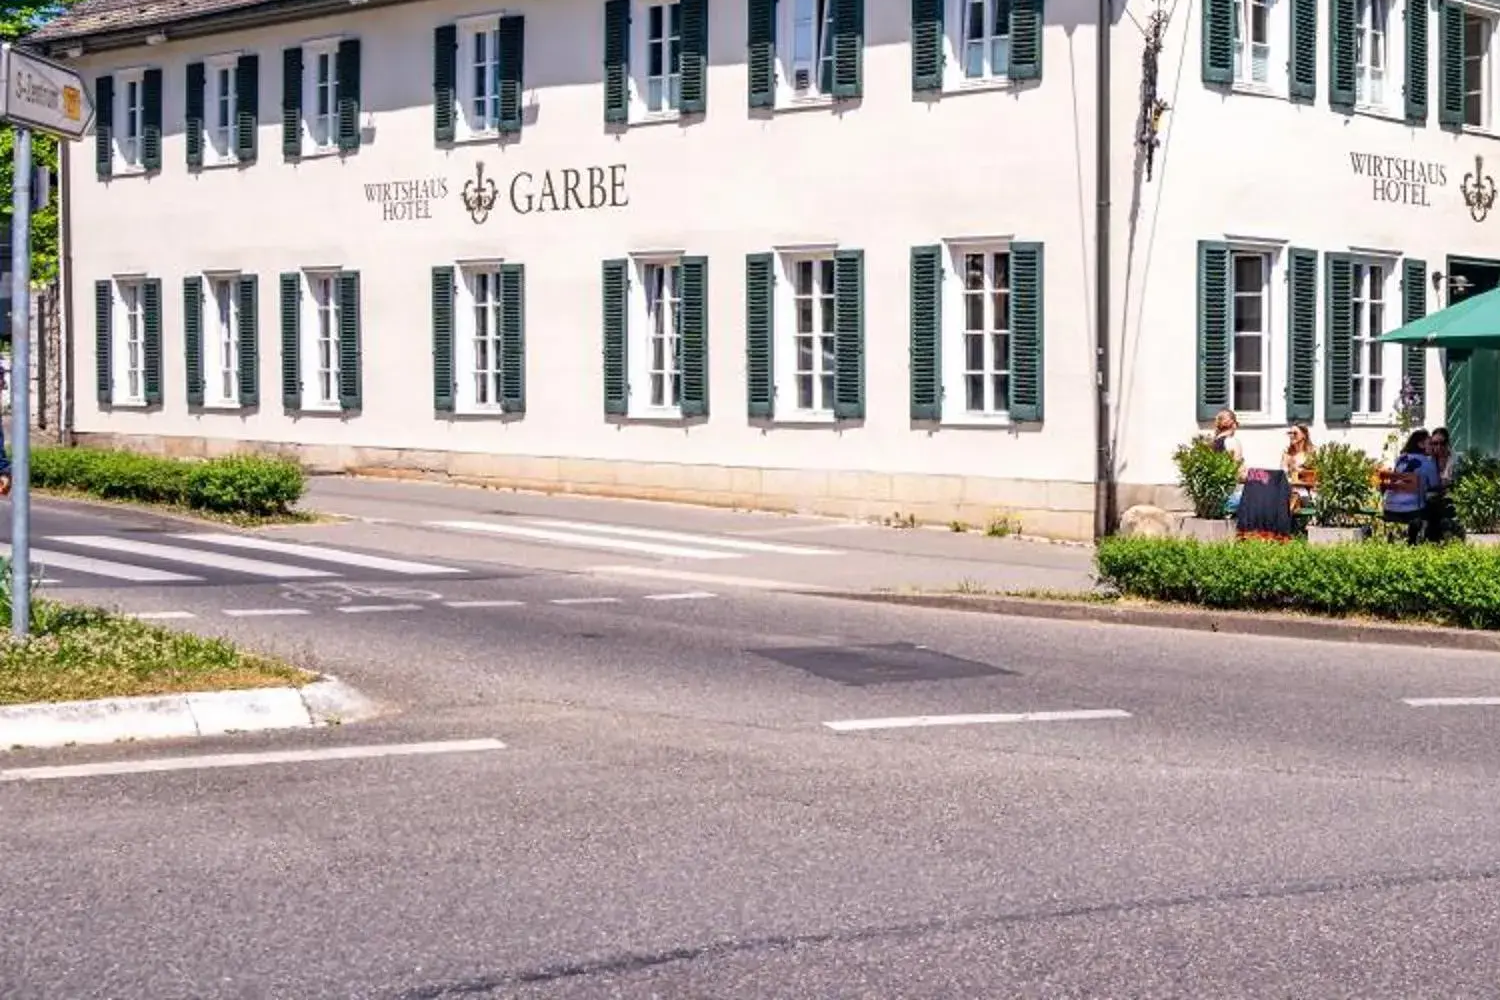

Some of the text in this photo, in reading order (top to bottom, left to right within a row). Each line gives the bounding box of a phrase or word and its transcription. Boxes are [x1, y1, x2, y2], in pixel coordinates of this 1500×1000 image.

[1349, 151, 1448, 187] WIRTSHAUS
[363, 177, 449, 201] WIRTSHAUS
[509, 163, 630, 215] GARBE
[1373, 178, 1431, 207] HOTEL
[382, 200, 432, 221] HOTEL
